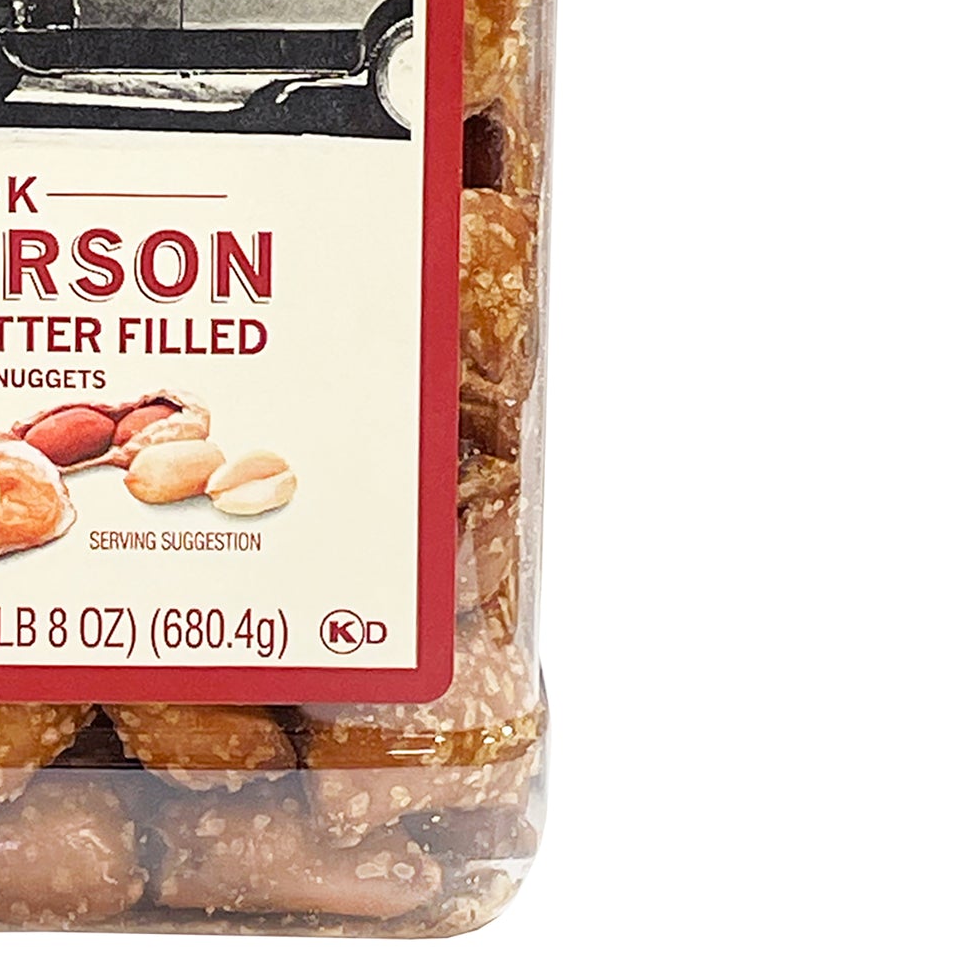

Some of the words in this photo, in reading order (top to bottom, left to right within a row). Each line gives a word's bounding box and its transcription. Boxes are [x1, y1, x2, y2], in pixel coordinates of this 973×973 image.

[119, 317, 267, 355] FILLED
[90, 531, 156, 550] SERVING
[162, 532, 260, 551] SUGGESTION
[49, 608, 67, 648] 8
[80, 607, 136, 658] OZ)
[151, 608, 288, 659] (680.4g)
